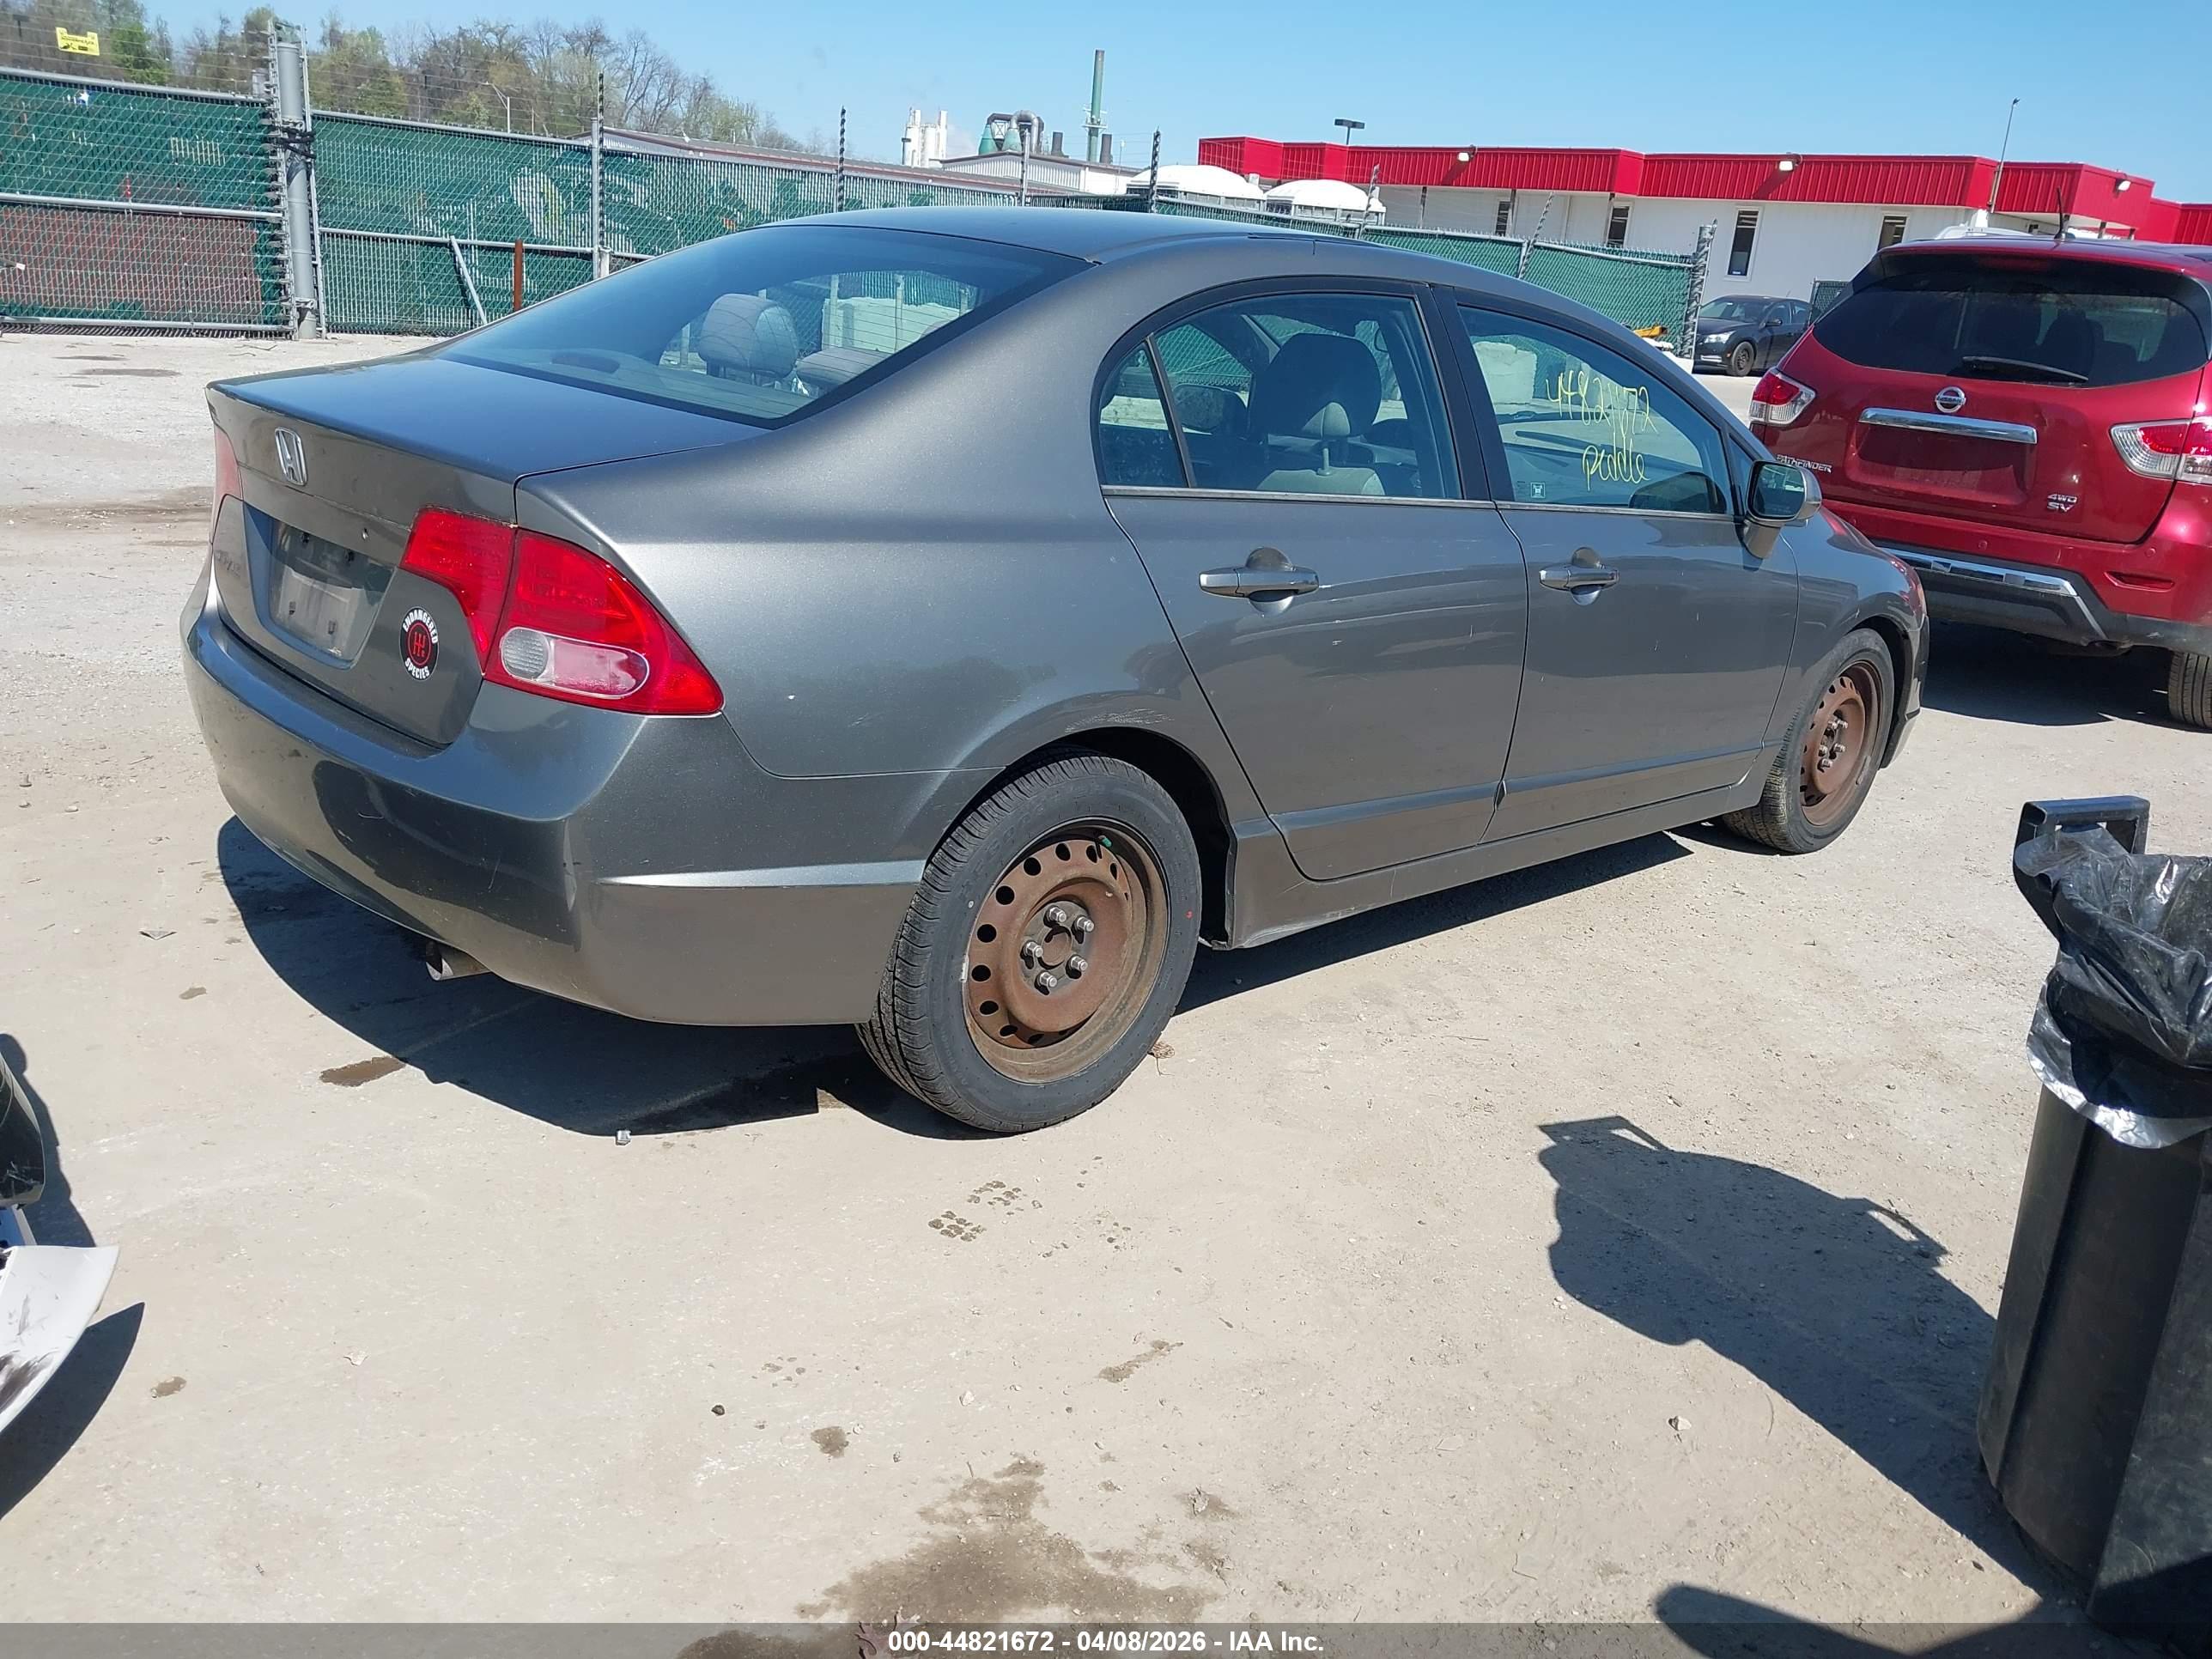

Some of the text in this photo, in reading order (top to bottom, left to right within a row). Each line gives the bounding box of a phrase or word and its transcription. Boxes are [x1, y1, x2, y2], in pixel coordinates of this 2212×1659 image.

[2047, 493, 2077, 503] 4WD
[2047, 502, 2074, 512] SV
[402, 609, 439, 644] ENDANGERED
[404, 658, 430, 679] SPECIES
